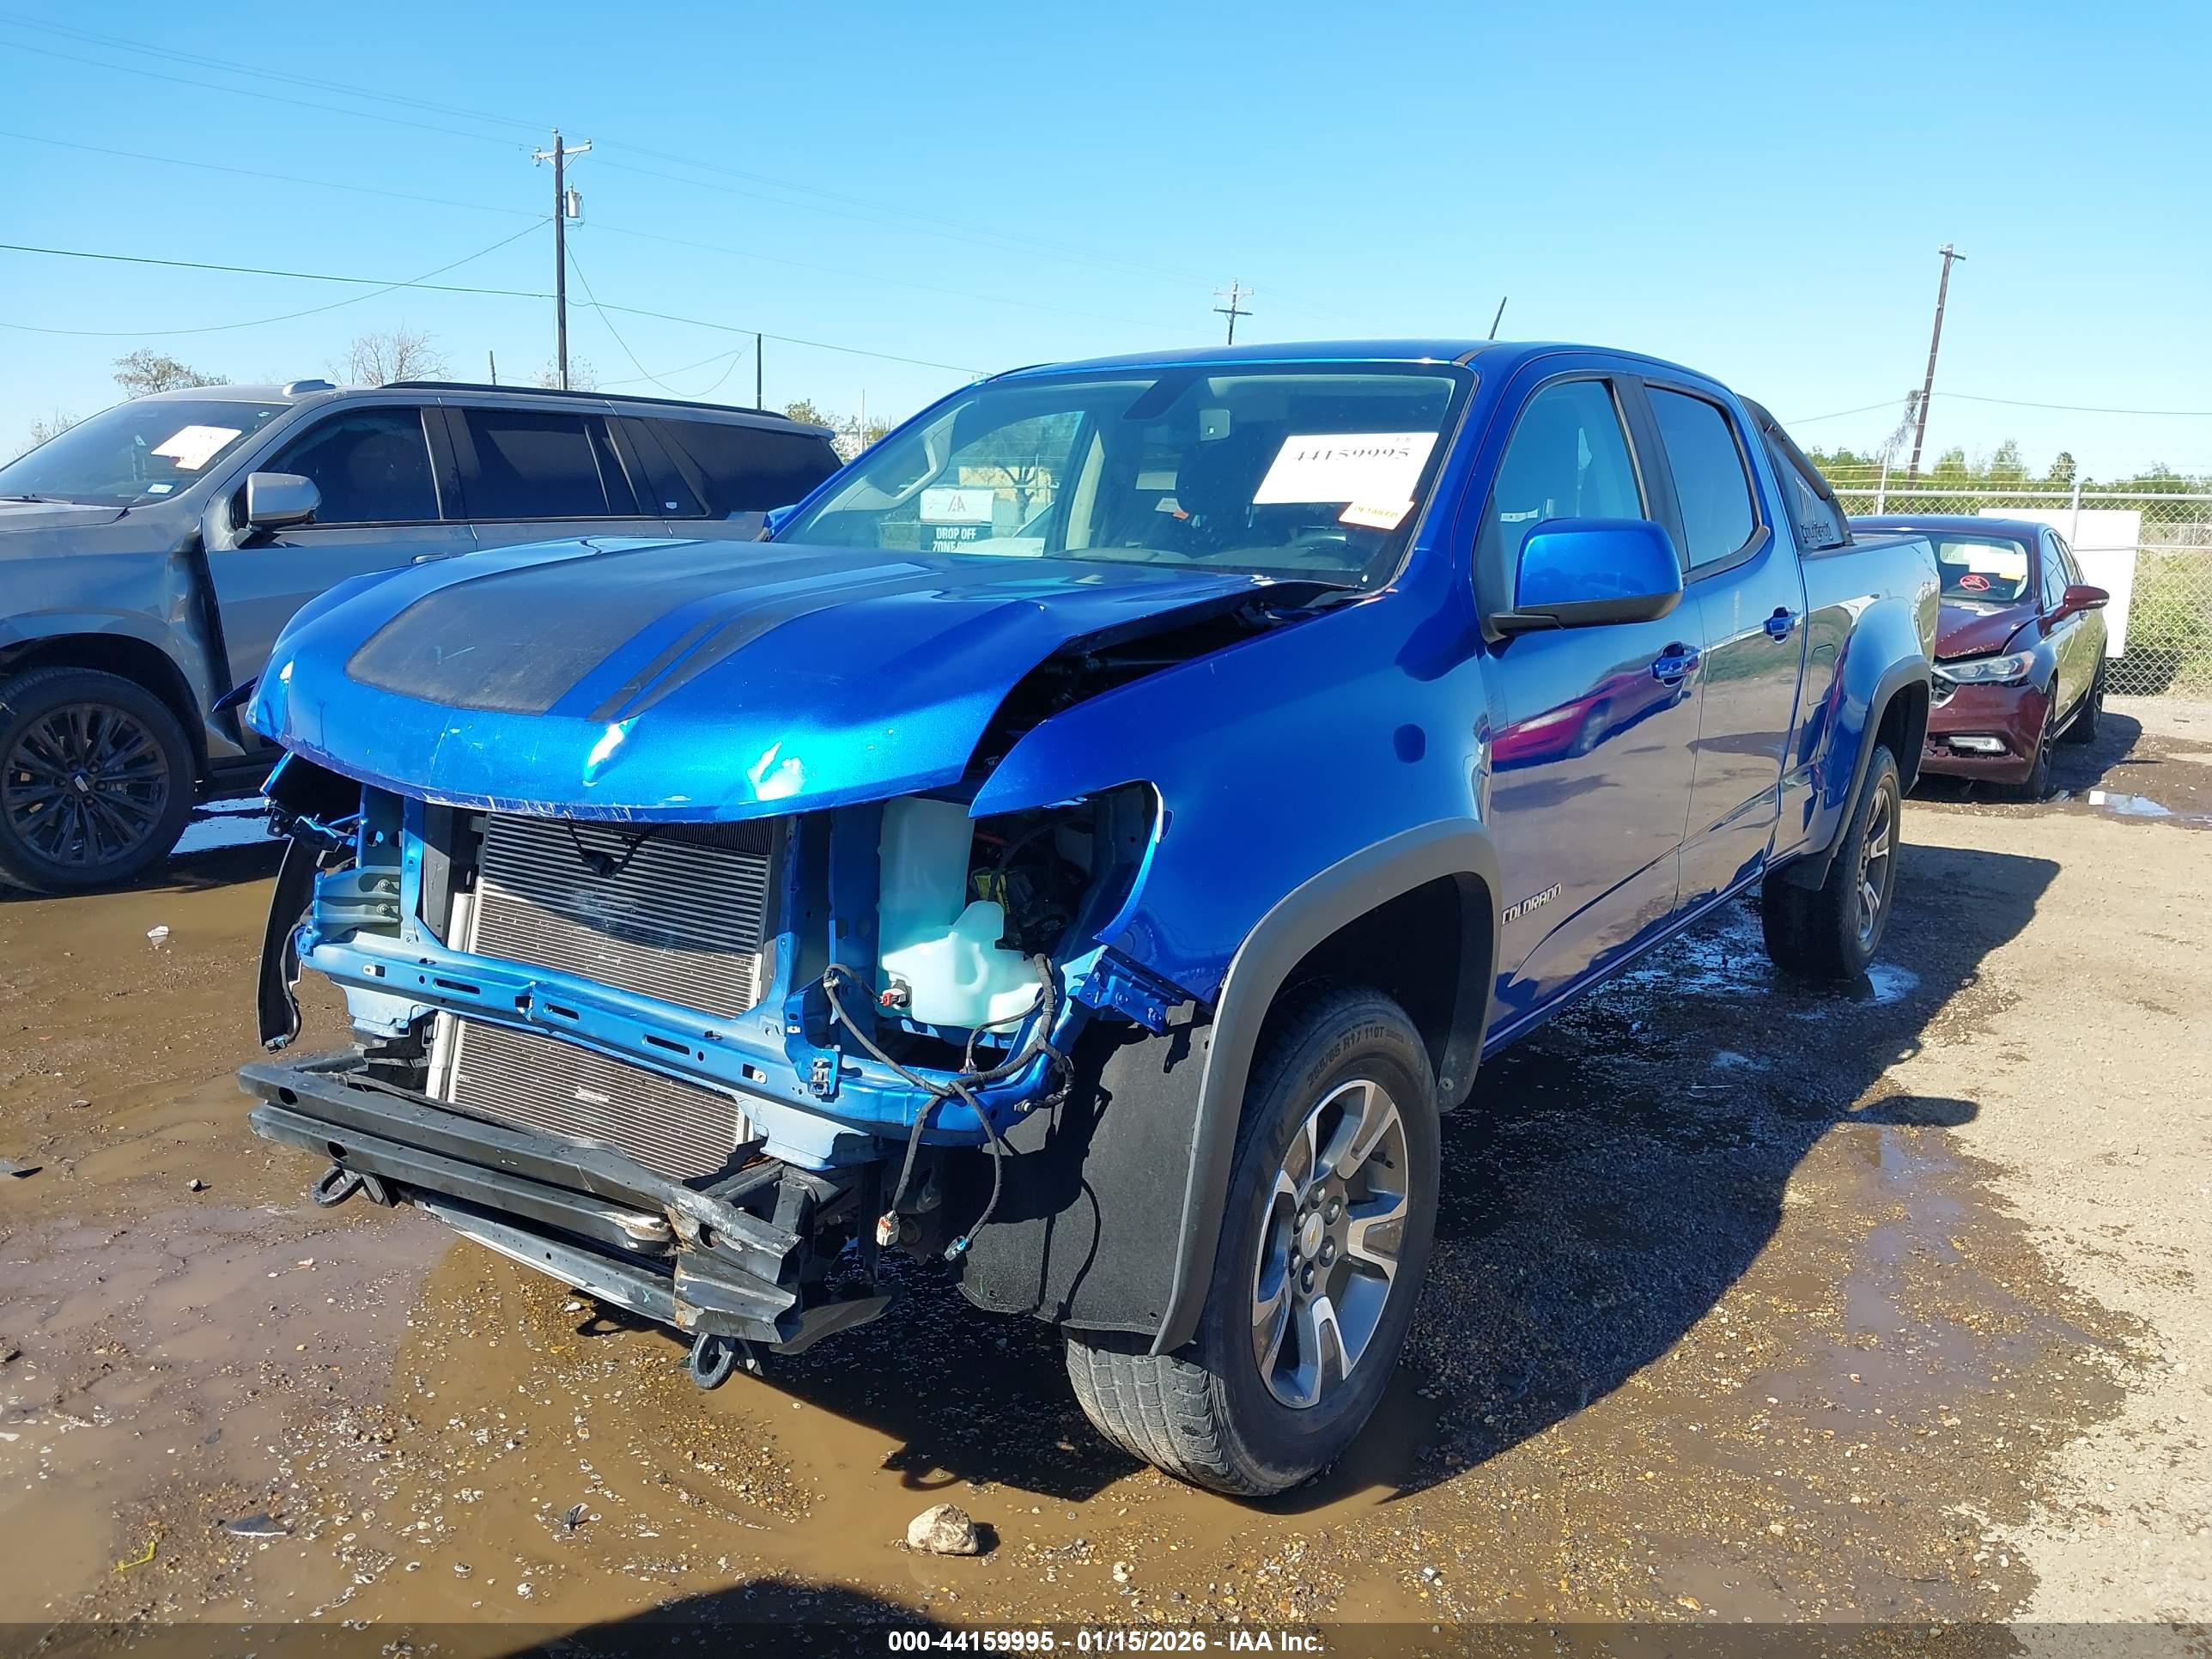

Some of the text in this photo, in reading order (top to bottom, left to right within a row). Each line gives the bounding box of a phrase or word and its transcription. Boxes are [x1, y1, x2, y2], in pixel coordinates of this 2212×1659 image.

[936, 527, 977, 540] DROP OFF
[1502, 883, 1562, 926] COLORADO
[1364, 1026, 1385, 1039] 110T
